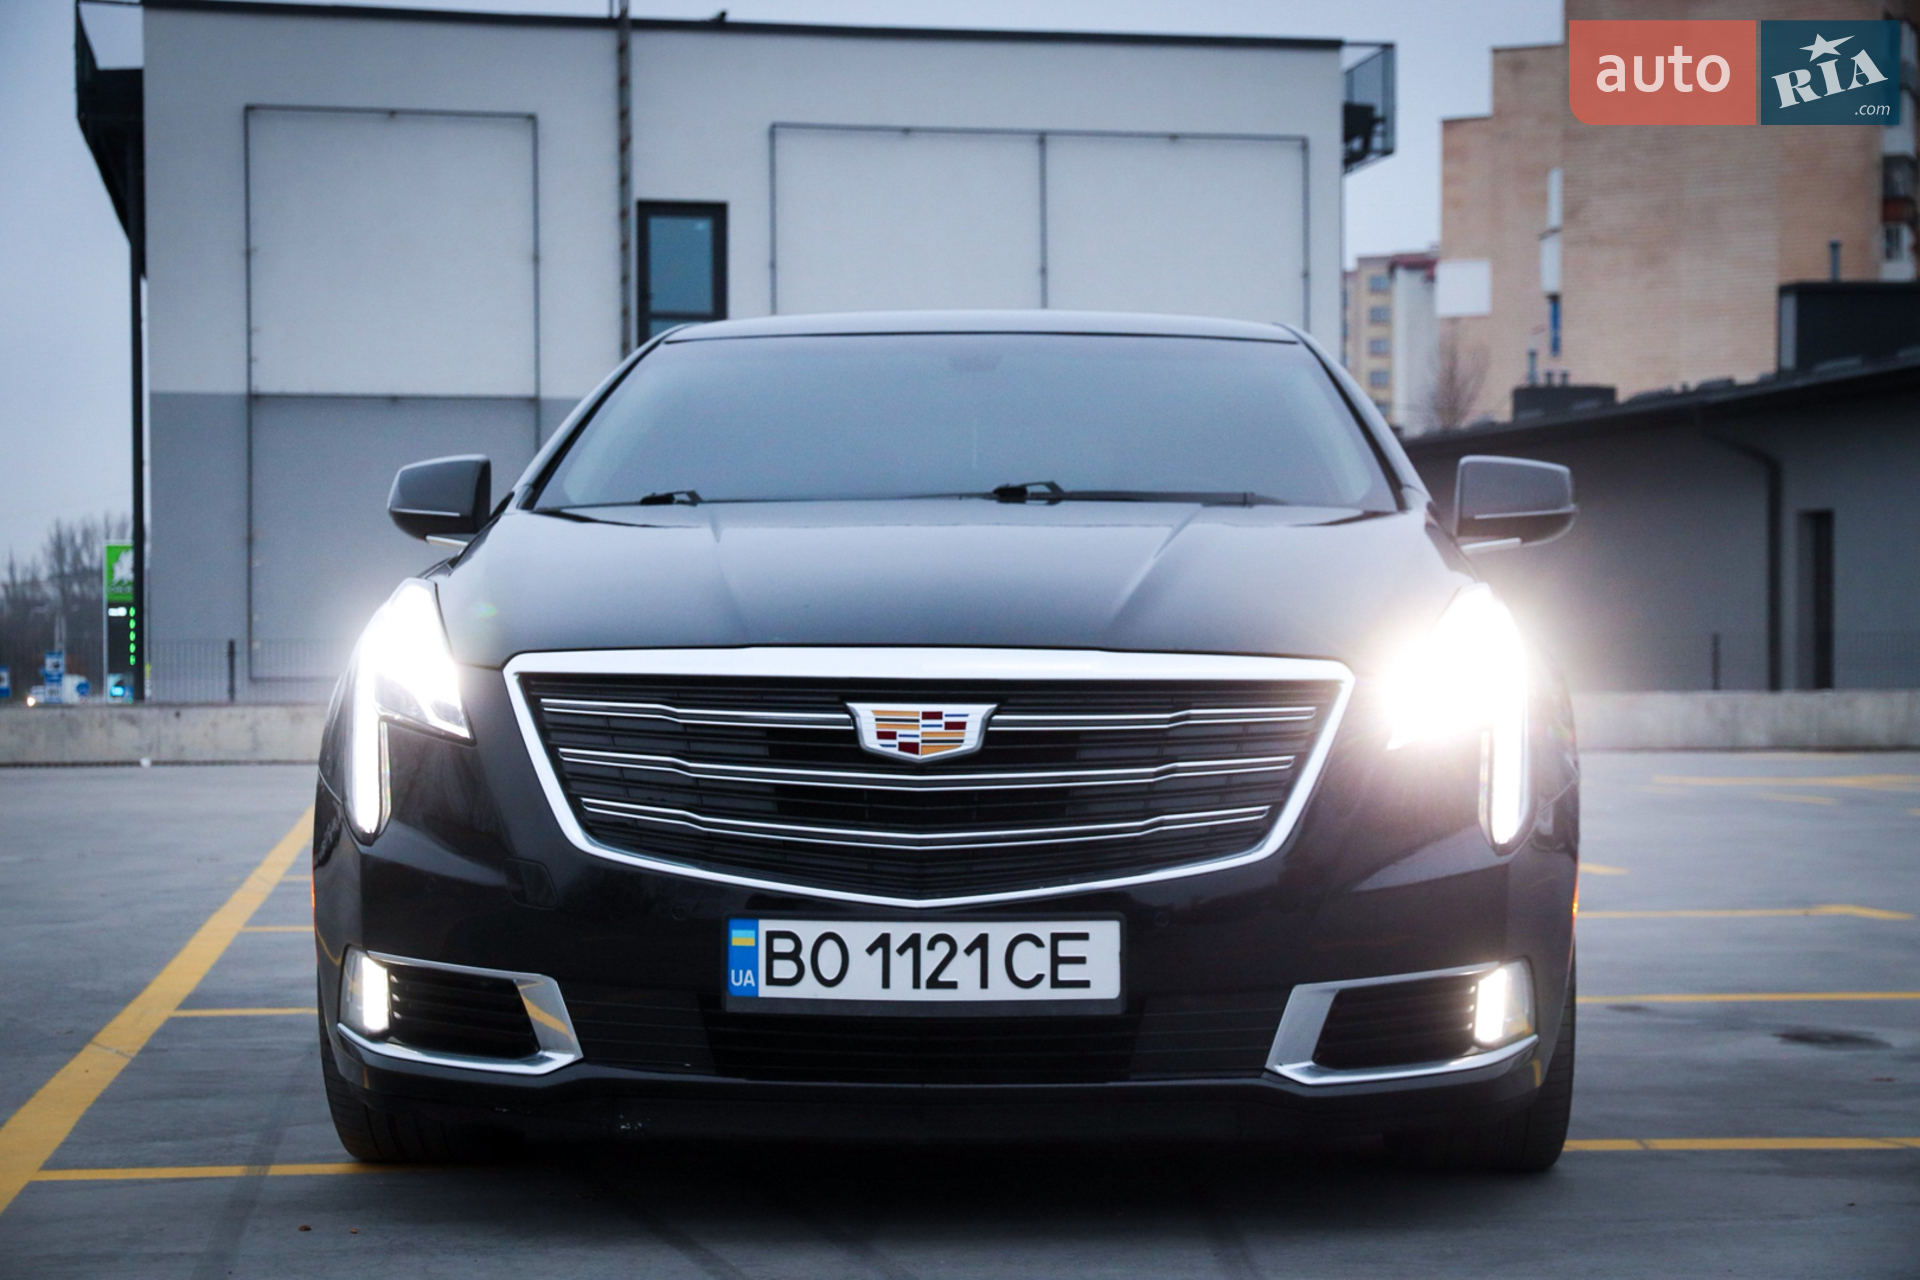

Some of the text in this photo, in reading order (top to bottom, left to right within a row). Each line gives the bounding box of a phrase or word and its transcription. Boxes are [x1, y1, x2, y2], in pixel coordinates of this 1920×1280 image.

[731, 969, 756, 987] UA
[765, 930, 1091, 990] BO 1121 CE
